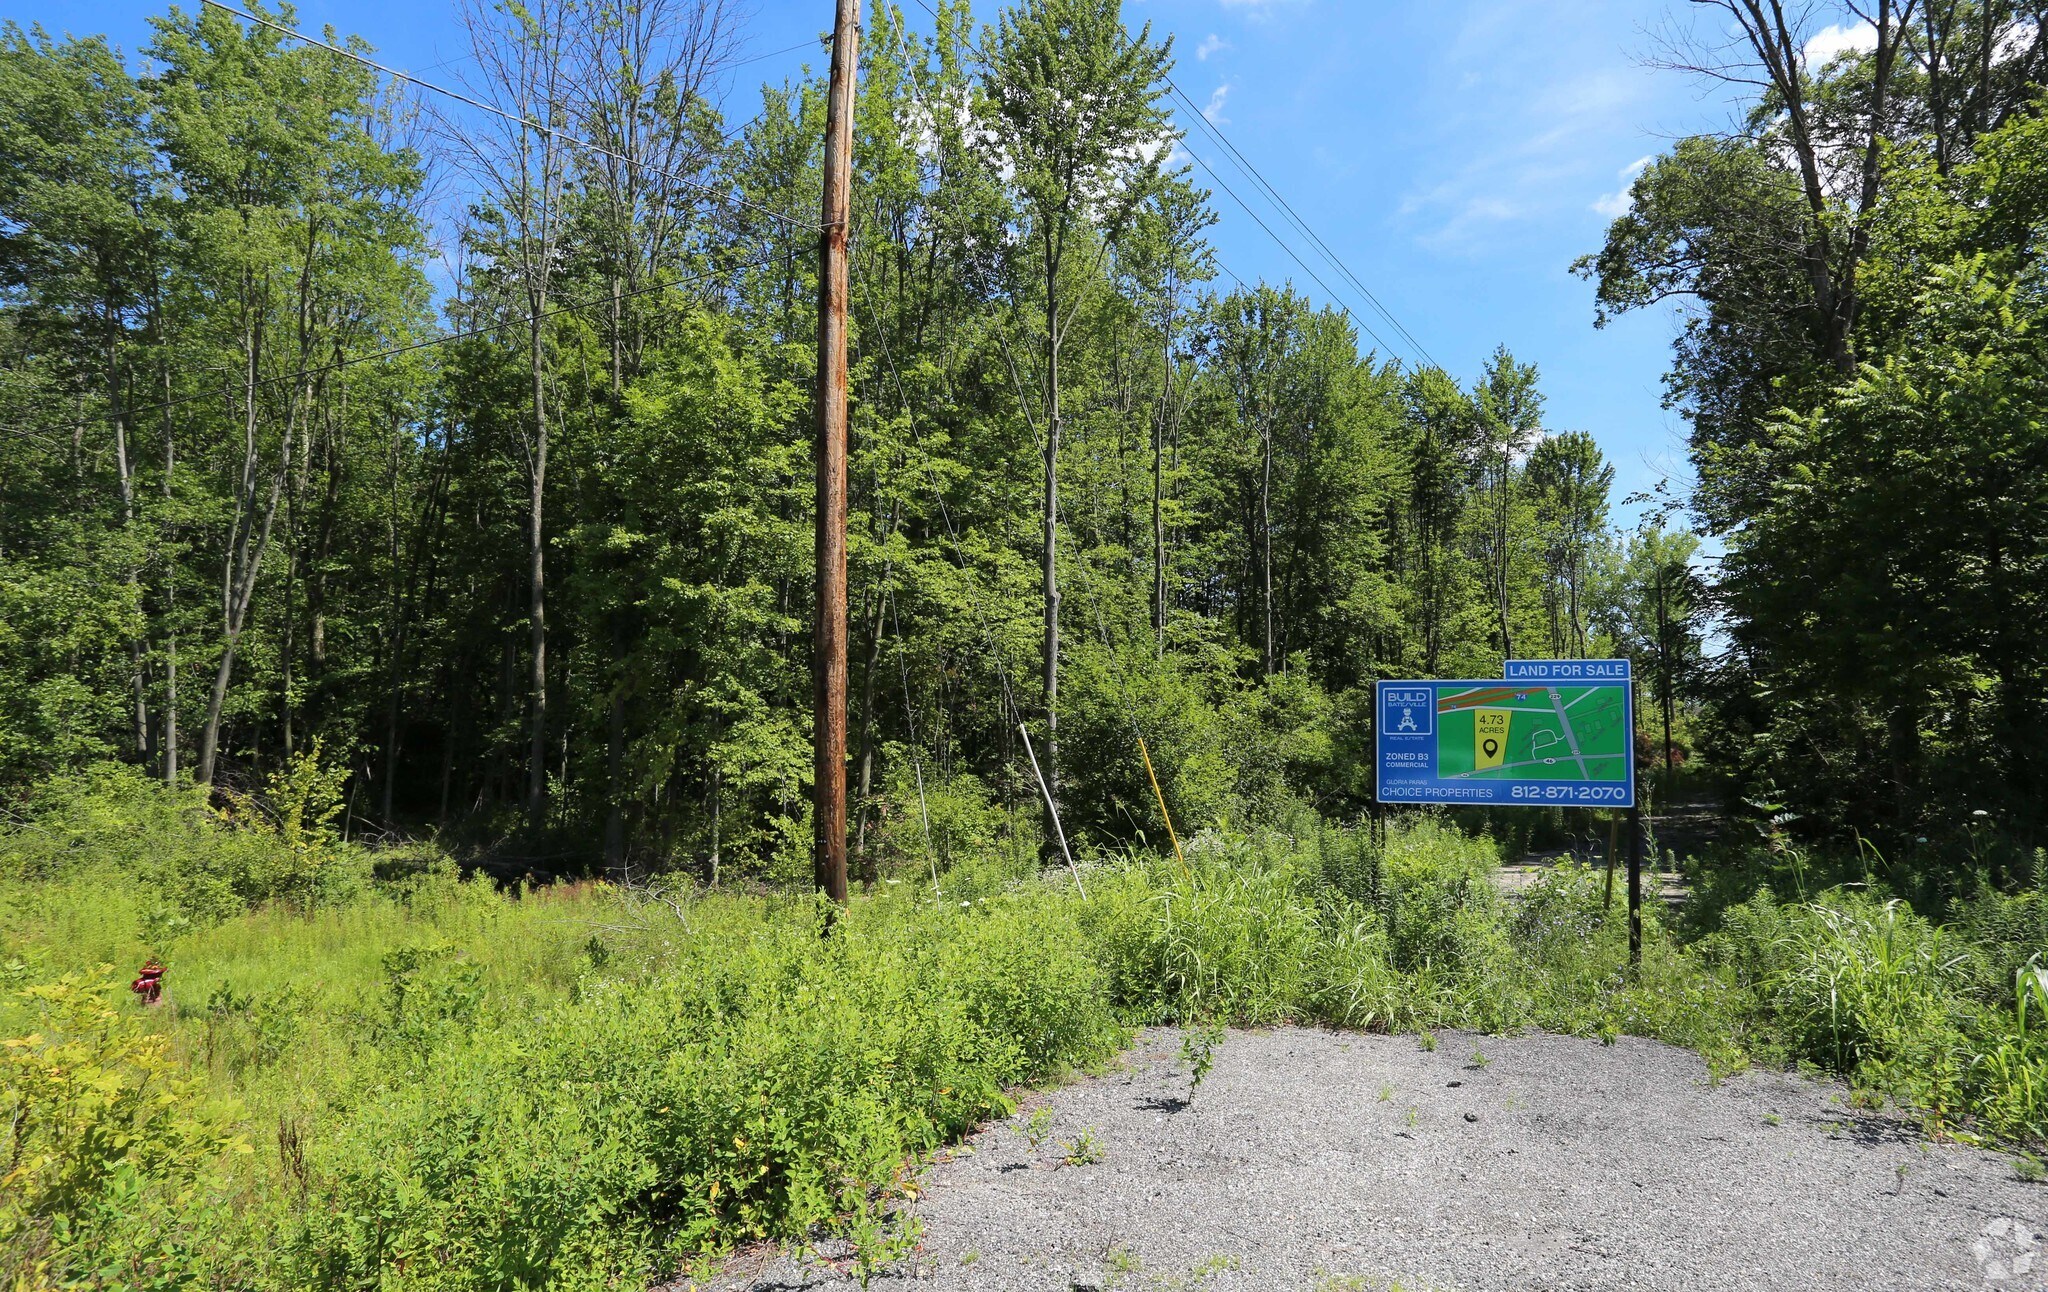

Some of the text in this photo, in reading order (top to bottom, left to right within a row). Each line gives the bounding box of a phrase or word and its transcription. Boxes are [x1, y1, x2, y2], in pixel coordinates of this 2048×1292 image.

[1510, 665, 1624, 676] LAND FOR SALE
[1388, 693, 1426, 701] BUILD
[1480, 715, 1504, 724] 4.73
[1382, 788, 1493, 798] CHOICE PROPERTIES
